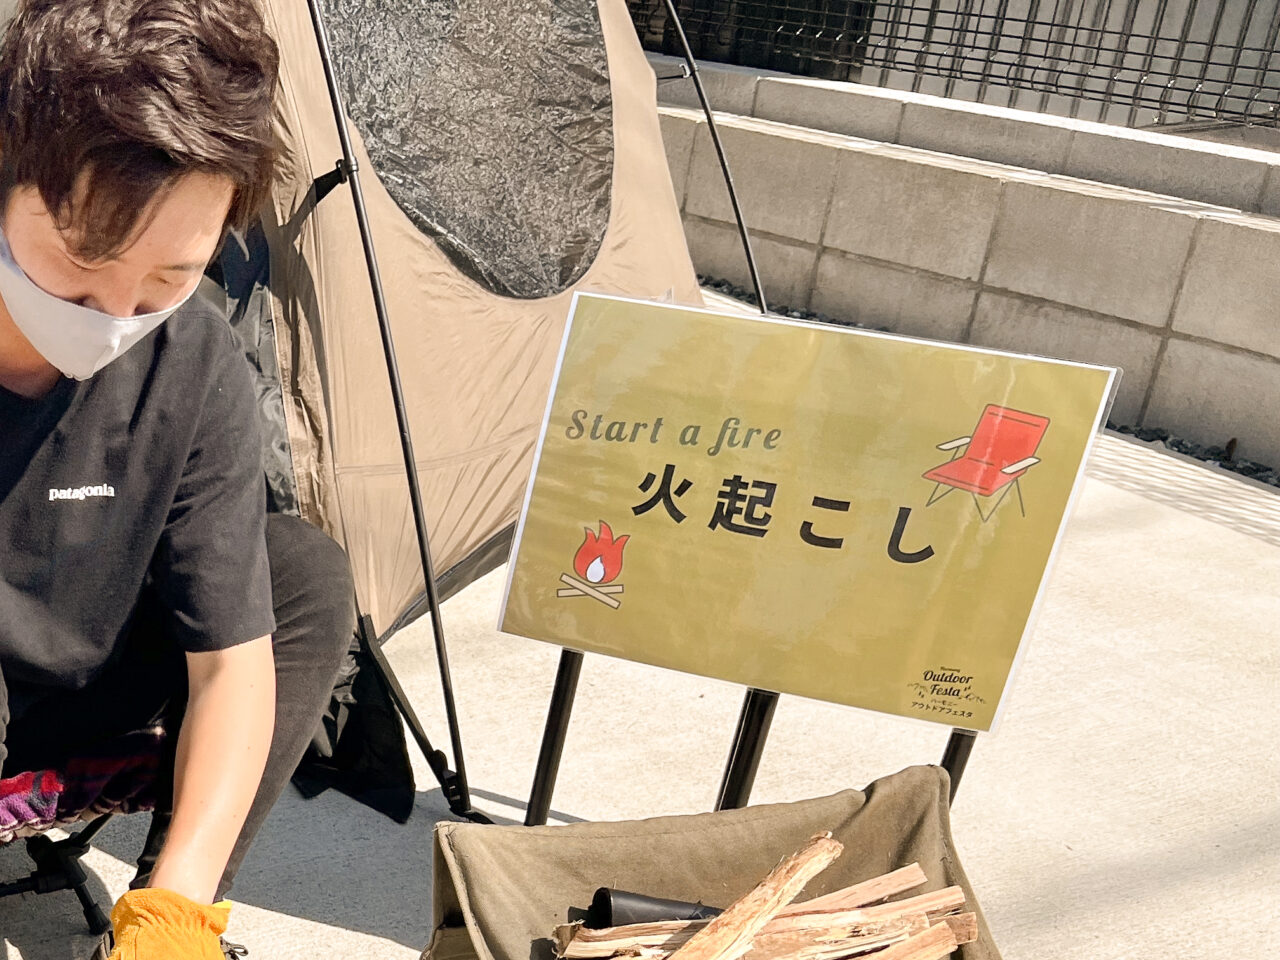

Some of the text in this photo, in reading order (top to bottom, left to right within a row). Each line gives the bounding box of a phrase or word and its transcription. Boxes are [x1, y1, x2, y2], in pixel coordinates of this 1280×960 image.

[565, 409, 782, 457] Start a fire
[48, 483, 115, 501] patagonia
[631, 463, 936, 564] 火起こし
[923, 670, 974, 684] Outdoor
[930, 684, 961, 697] Festa
